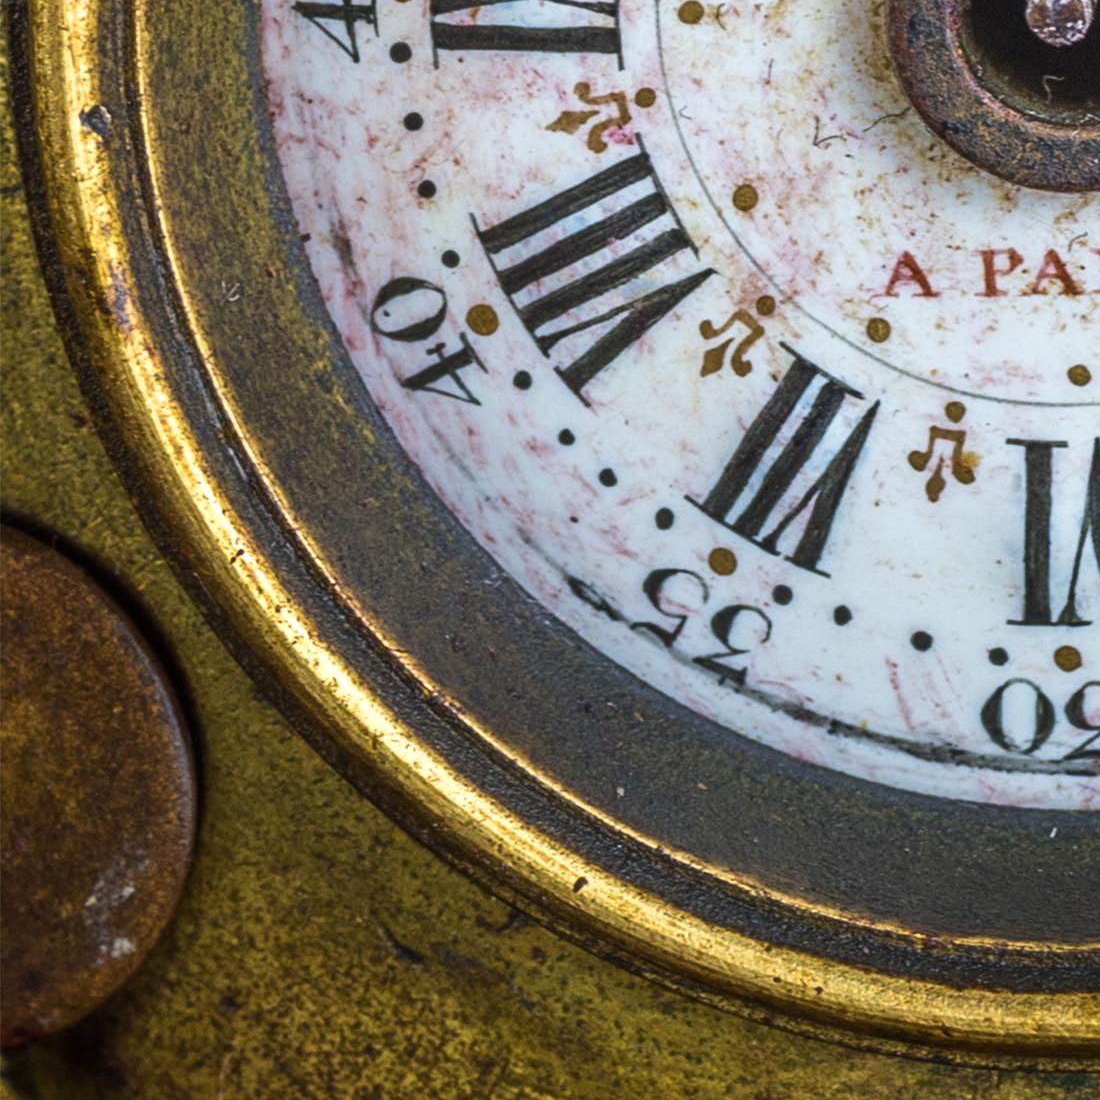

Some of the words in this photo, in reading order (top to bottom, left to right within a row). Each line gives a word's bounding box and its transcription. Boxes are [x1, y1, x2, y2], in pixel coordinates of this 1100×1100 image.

[470, 132, 719, 408] VIII
[869, 250, 942, 299] A
[370, 276, 487, 406] 40
[685, 341, 880, 578] VII
[632, 568, 771, 693] 35
